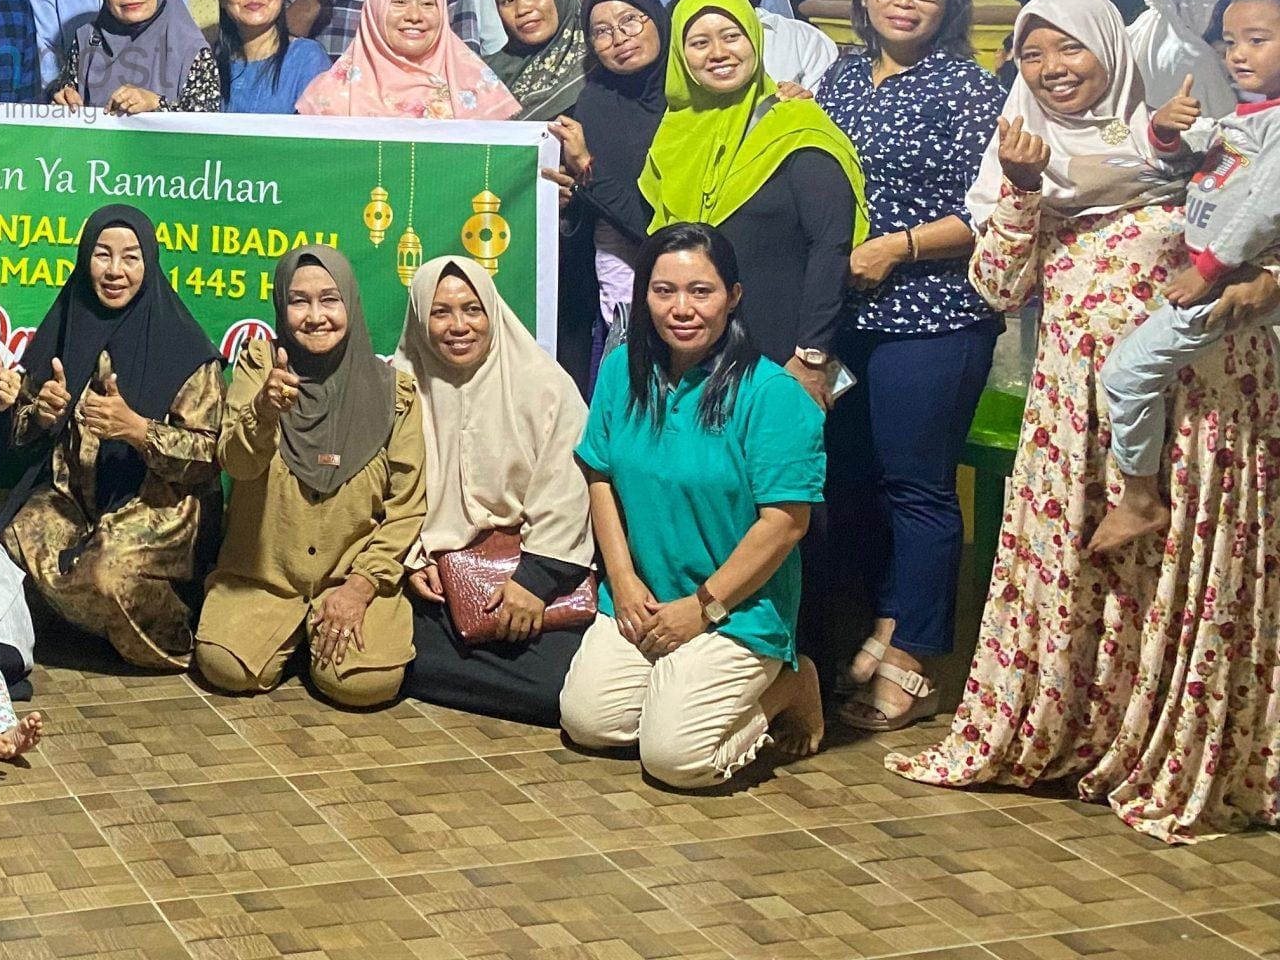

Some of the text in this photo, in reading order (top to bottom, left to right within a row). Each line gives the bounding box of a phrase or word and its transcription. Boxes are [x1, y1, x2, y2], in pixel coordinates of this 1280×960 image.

[34, 157, 77, 193] Ya
[86, 159, 283, 205] Ramadhan
[168, 265, 247, 299] 1445
